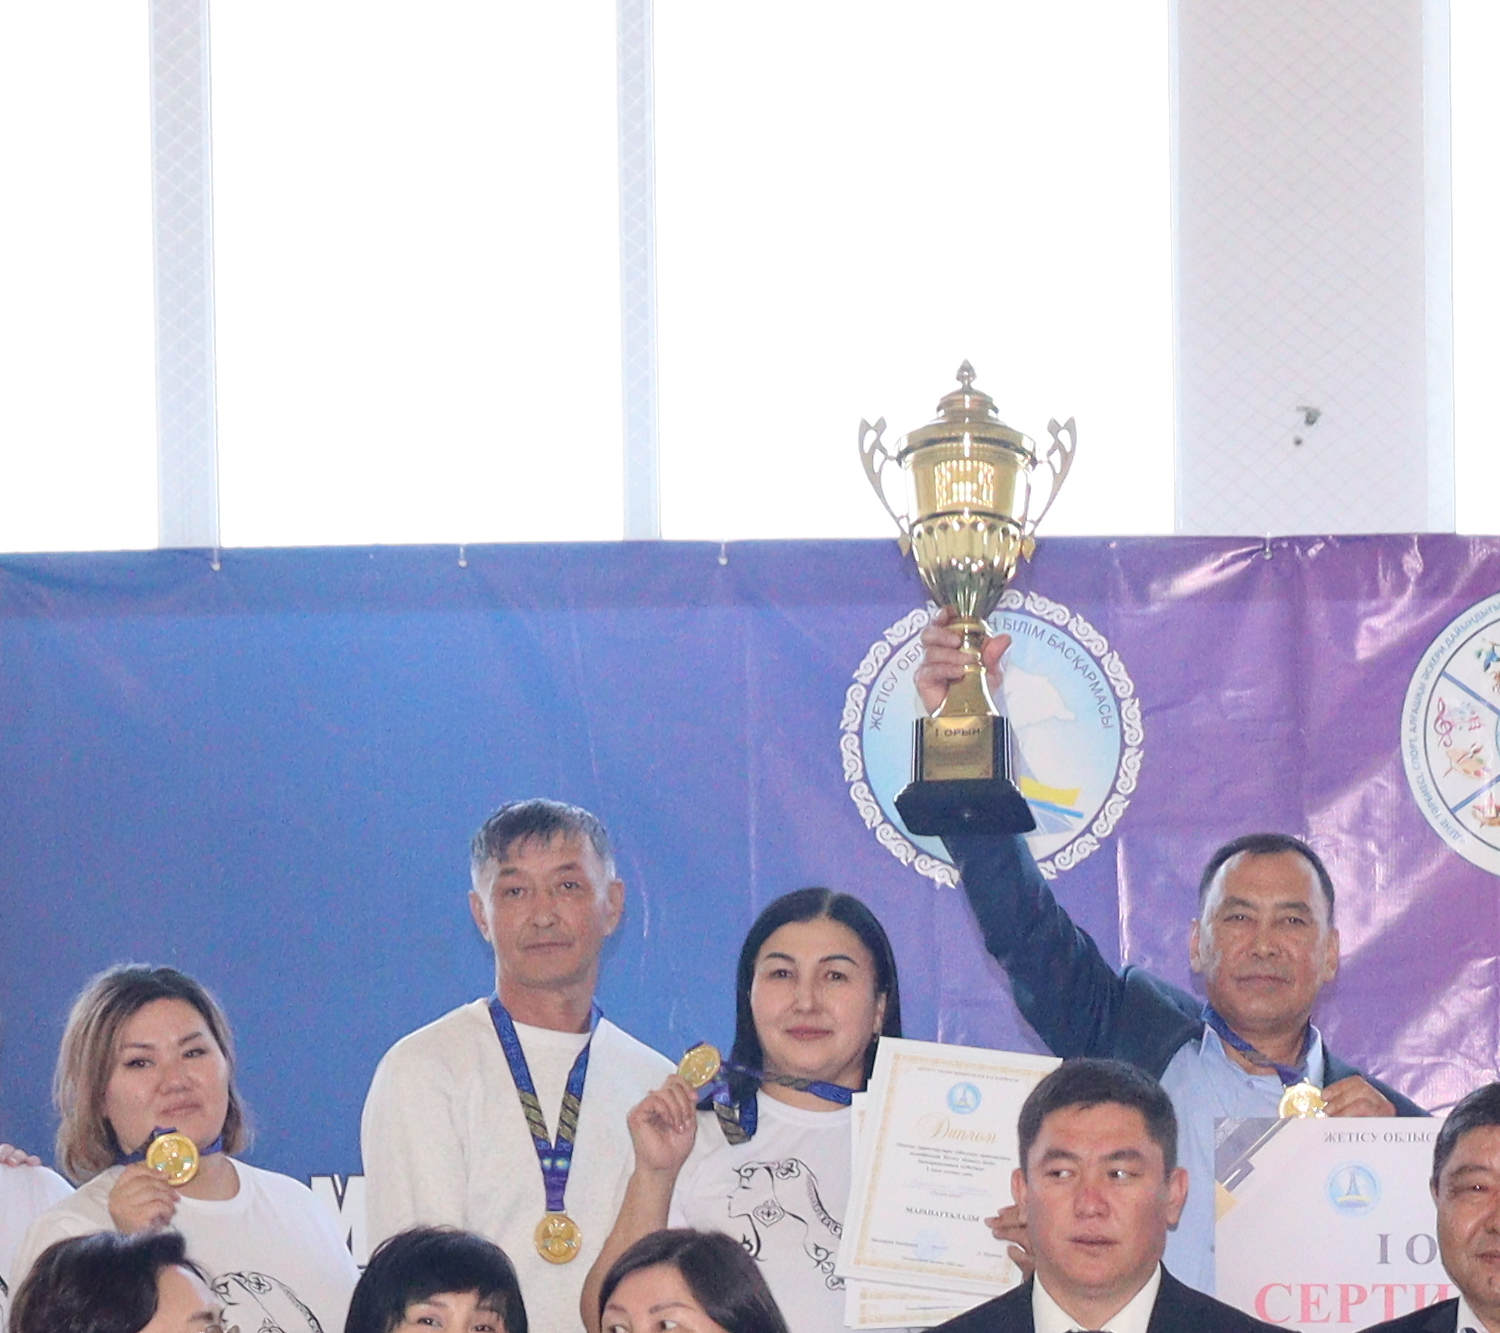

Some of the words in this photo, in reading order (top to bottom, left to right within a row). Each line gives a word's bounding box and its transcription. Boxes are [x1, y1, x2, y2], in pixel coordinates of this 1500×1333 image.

[869, 667, 899, 731] ЖЕТІСУ
[1002, 618, 1045, 640] БІЛІМ
[1047, 633, 1115, 730] БАСҚАРМАСЫ
[1323, 1131, 1379, 1143] ЖЕТІСУ
[1383, 1131, 1438, 1143] ОБЛЫС
